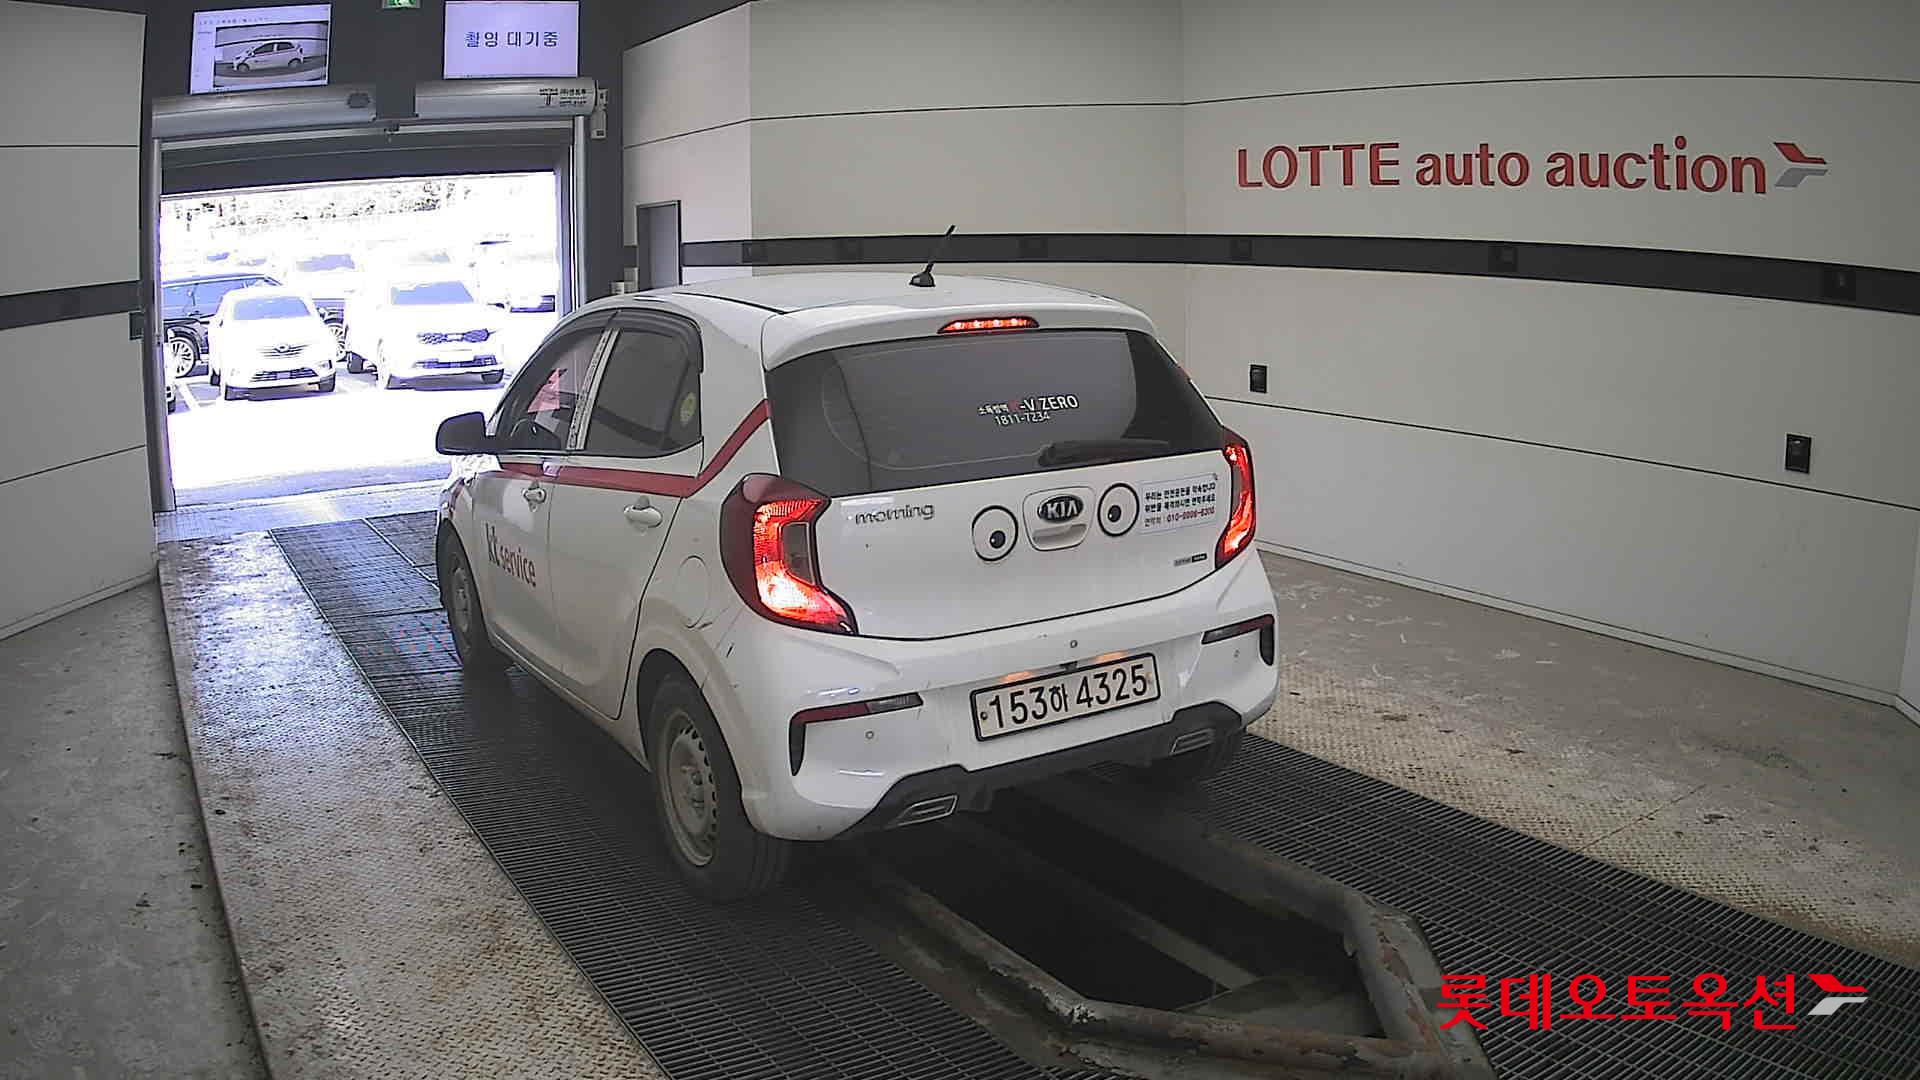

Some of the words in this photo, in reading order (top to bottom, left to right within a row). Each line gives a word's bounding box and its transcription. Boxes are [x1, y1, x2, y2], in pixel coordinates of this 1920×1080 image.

[465, 31, 498, 47] 촬영
[507, 31, 558, 47] 대기중
[1237, 142, 1400, 189] LOTTE
[1415, 143, 1530, 187] auto
[1546, 135, 1766, 194] auction
[1038, 395, 1079, 411] ZERO
[994, 411, 1050, 425] 1811-7234
[855, 504, 935, 525] morning
[500, 545, 537, 588] service
[989, 684, 1069, 729] 153하
[1076, 663, 1148, 708] 4325
